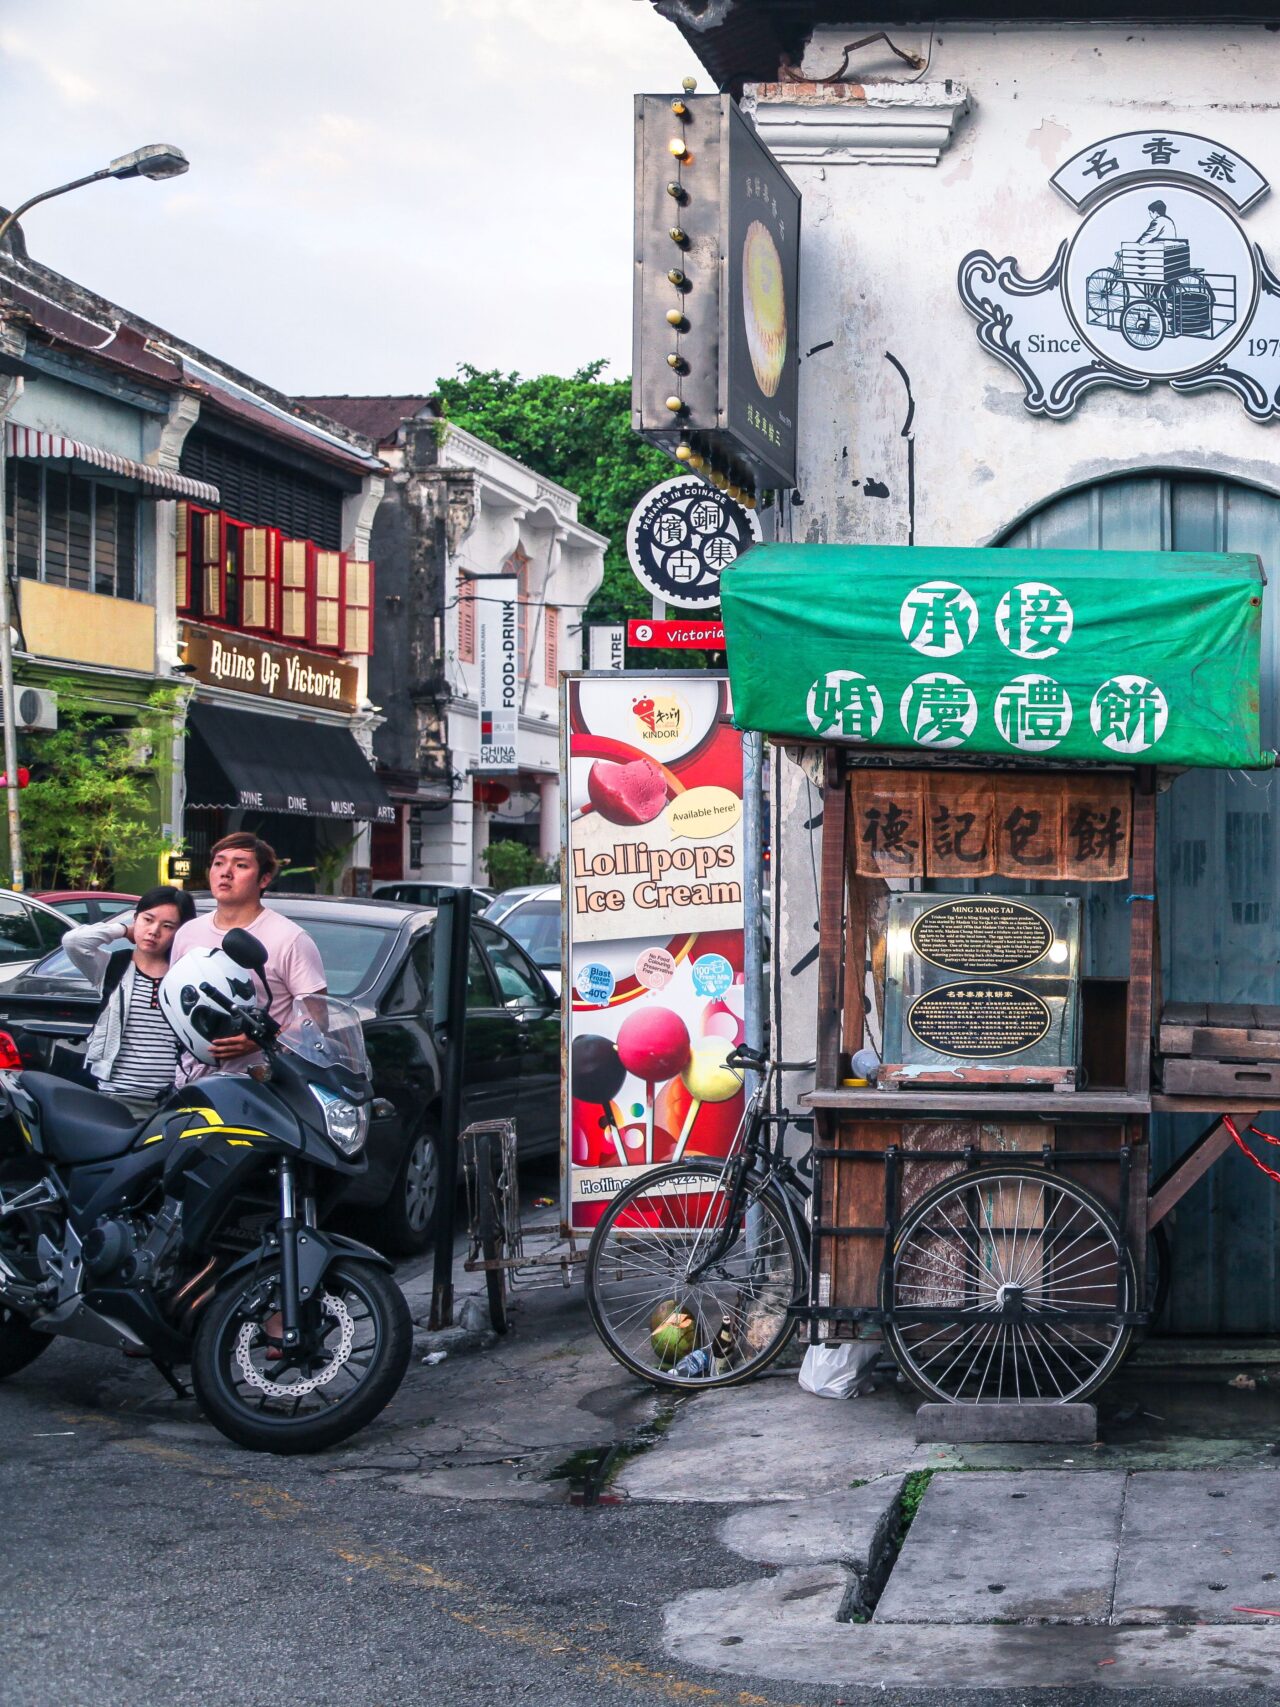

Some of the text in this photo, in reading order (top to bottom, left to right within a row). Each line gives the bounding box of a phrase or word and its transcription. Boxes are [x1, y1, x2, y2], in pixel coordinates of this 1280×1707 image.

[1081, 138, 1237, 184] 名香泰
[1028, 335, 1080, 354] Since
[642, 488, 727, 530] PENANG IN COINAGE
[705, 539, 734, 567] 集
[669, 550, 697, 580] 古
[903, 584, 1071, 655] 承接
[667, 627, 725, 642] Victoria
[503, 600, 515, 708] FOOD+DRINK
[611, 632, 622, 670] ATRE
[210, 640, 341, 700] Ruins Of Victoria
[809, 674, 1166, 751] 婚慶禮餅
[642, 730, 679, 739] KINDORI
[480, 746, 515, 755] CHINA
[481, 755, 515, 764] HOUSE
[241, 791, 395, 819] WINE DINE MUSIC ARTS
[672, 803, 736, 822] Available here!
[174, 861, 191, 871] OPEN
[572, 842, 735, 881] Lollipops
[575, 881, 741, 914] Ice Cream
[648, 958, 671, 969] Colouring
[657, 955, 670, 963] Food
[590, 967, 611, 978] Blast
[643, 963, 674, 975] Preservative
[590, 975, 610, 983] Frozen
[580, 1177, 631, 1194] Hotline
